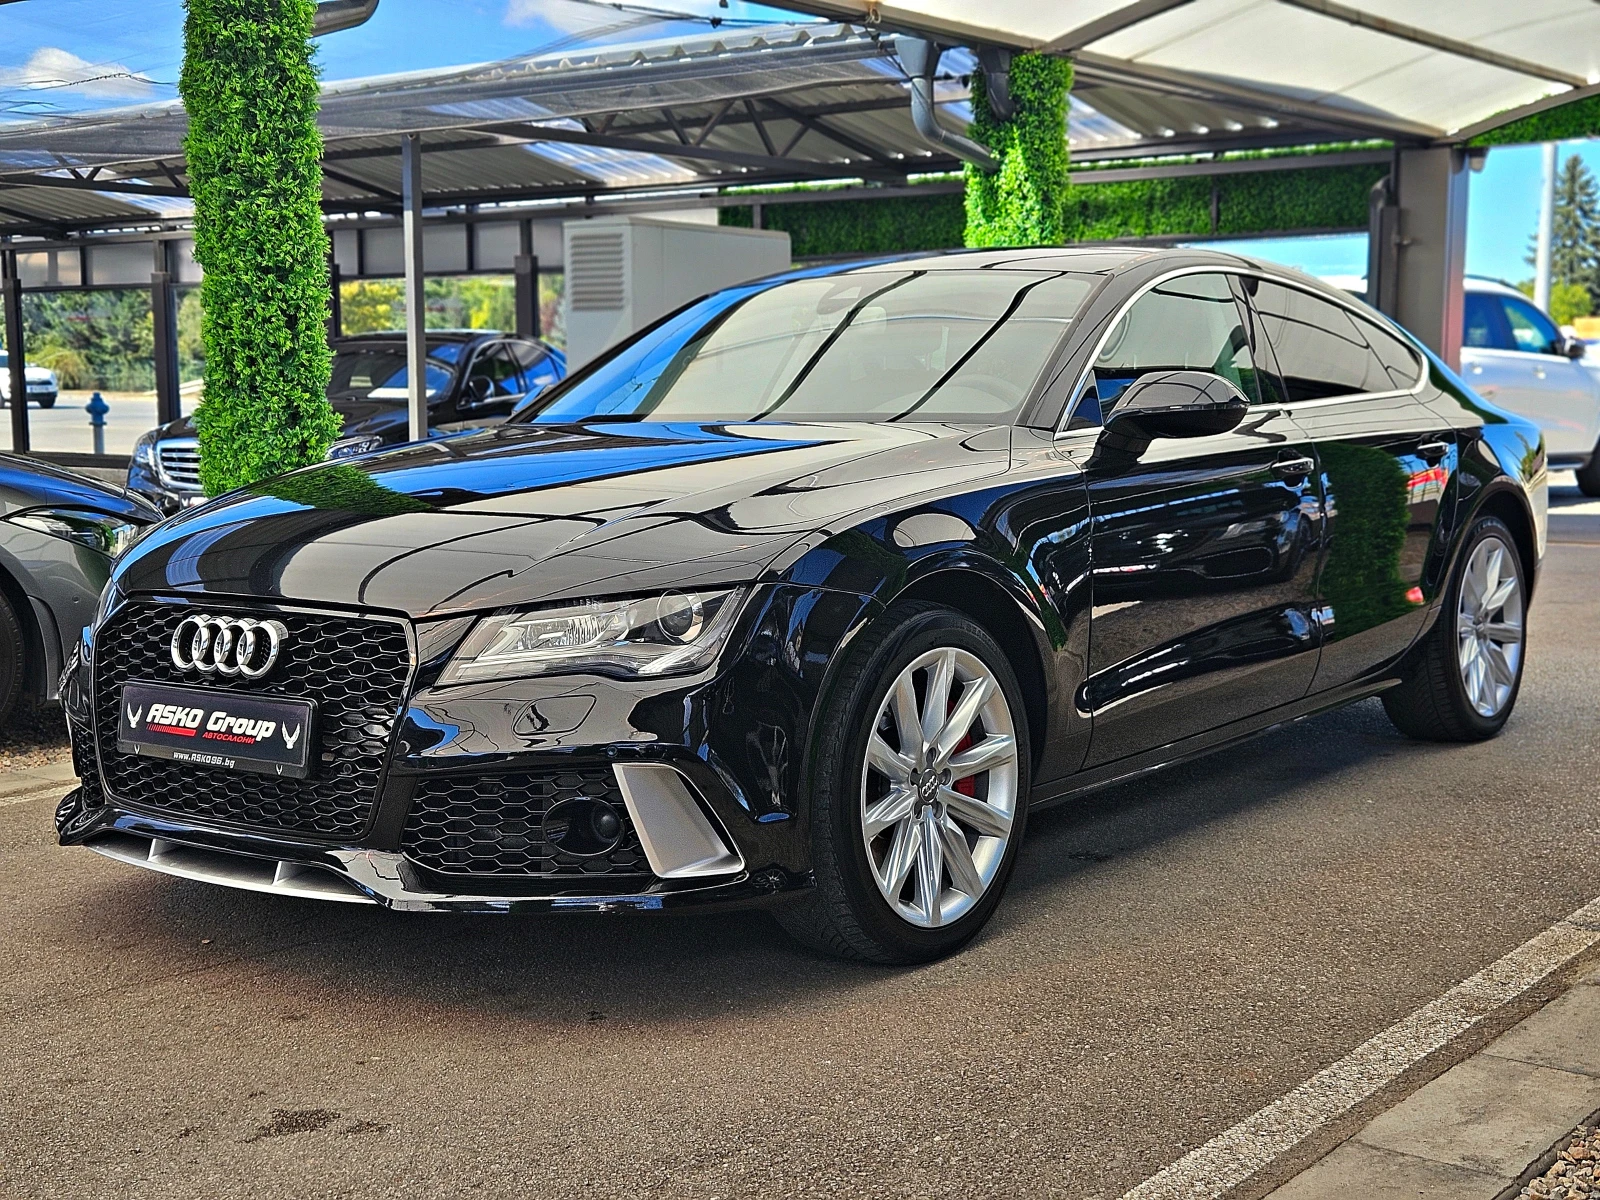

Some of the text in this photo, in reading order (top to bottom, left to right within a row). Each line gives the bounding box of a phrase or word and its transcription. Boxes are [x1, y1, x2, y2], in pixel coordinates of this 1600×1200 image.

[146, 704, 276, 741] ASKO Group
[202, 732, 255, 744] АВТОСАЛОНИ
